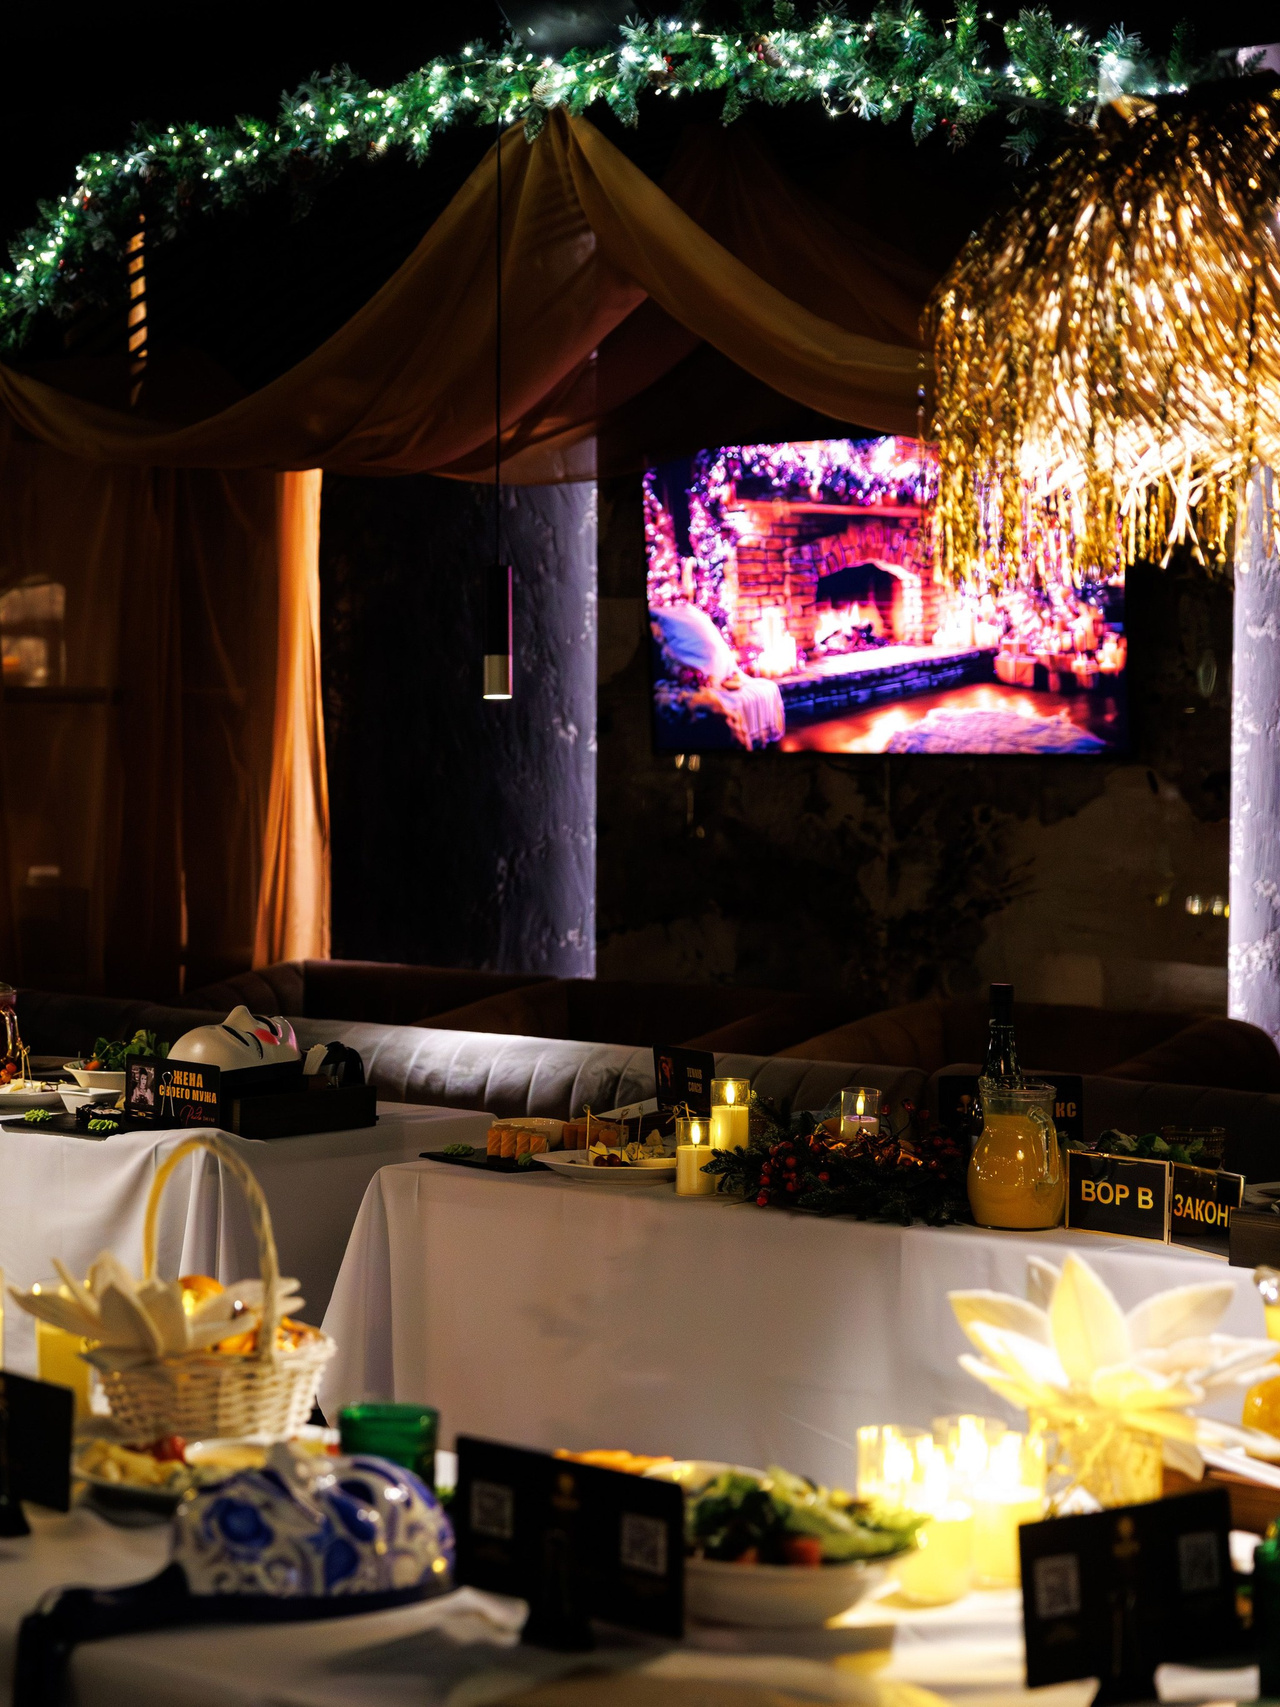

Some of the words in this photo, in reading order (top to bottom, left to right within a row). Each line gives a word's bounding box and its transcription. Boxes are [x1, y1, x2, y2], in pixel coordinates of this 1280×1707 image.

[173, 1069, 204, 1089] ЖЕНА
[191, 1089, 218, 1105] МУЖА
[1054, 1101, 1077, 1118] КС
[1081, 1179, 1130, 1206] ВОР
[1137, 1187, 1154, 1210] В
[1173, 1193, 1229, 1228] ЗАКОН
